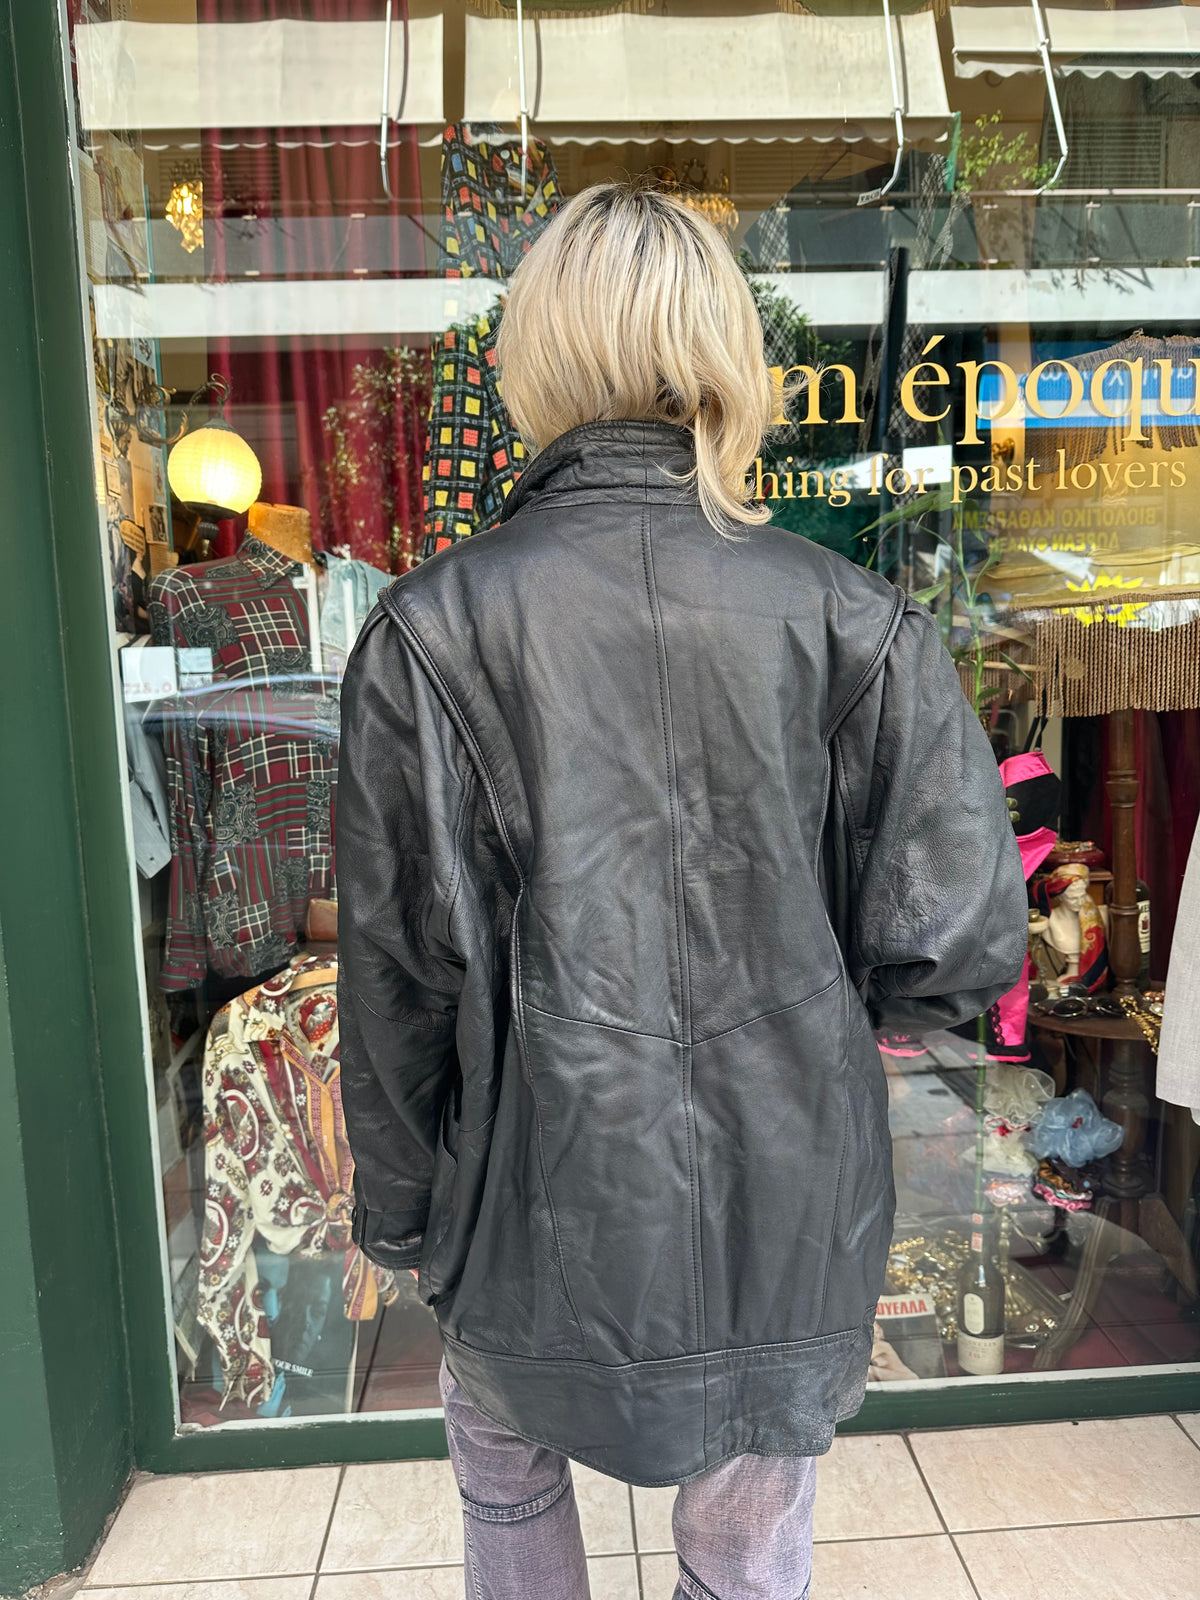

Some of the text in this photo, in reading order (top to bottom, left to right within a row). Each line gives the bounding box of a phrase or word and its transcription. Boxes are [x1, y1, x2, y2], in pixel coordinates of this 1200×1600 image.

[868, 453, 934, 495] for
[950, 458, 1042, 503] past
[1055, 448, 1187, 491] lovers
